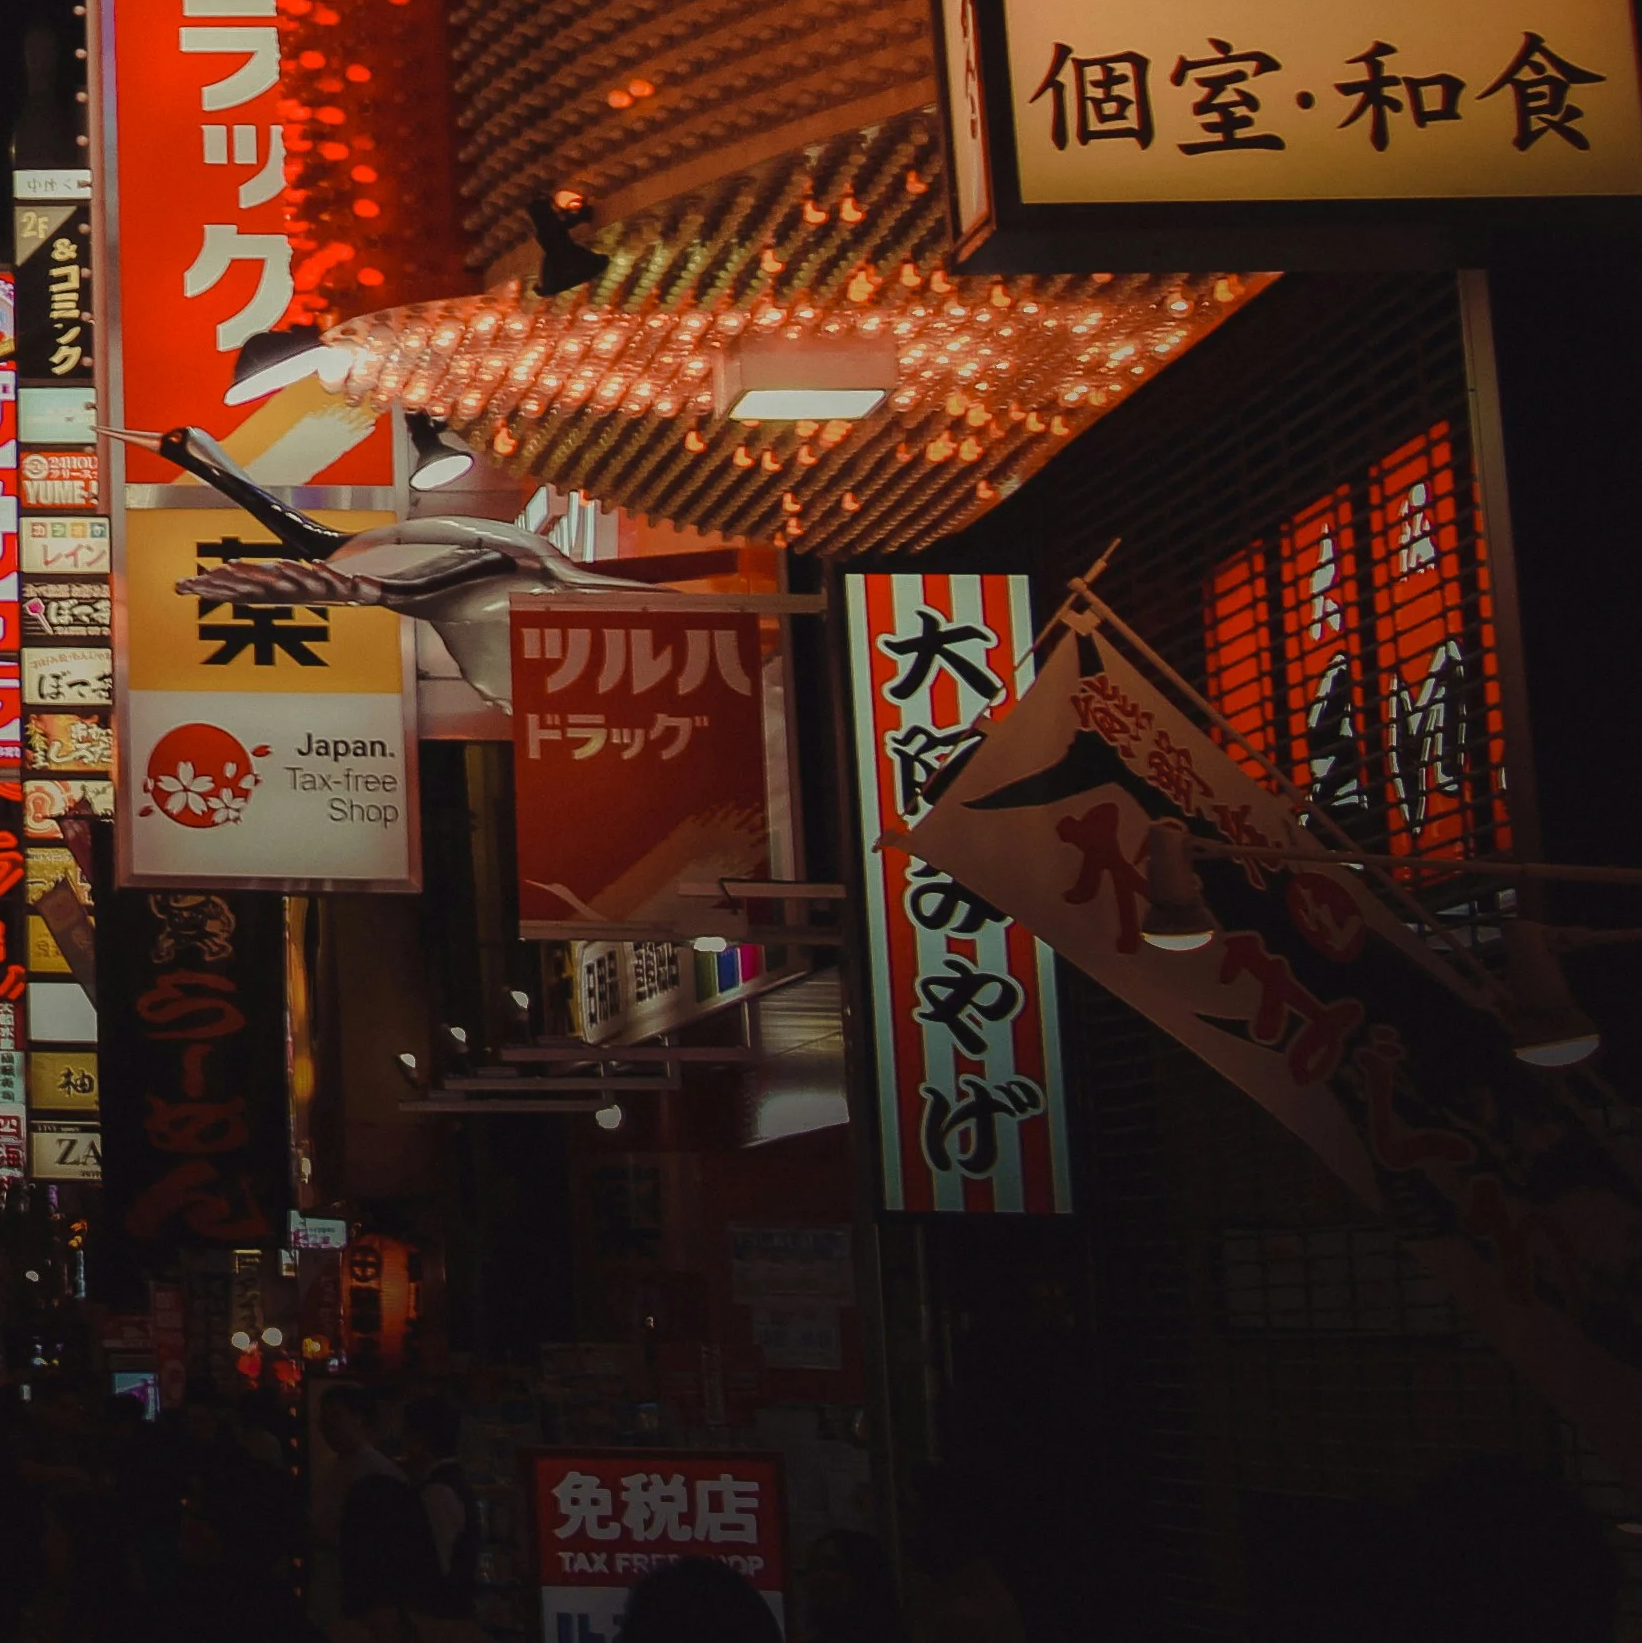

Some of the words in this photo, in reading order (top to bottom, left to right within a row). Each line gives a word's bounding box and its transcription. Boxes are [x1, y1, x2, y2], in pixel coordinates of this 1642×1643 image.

[1029, 31, 1607, 156] 個室・和食
[21, 211, 50, 239] 2F
[520, 627, 753, 697] ツルハ
[296, 732, 396, 761] Japan.
[525, 712, 710, 761] ドラッグ
[282, 764, 399, 794] Tax-free
[326, 796, 400, 827] Shop
[123, 968, 273, 1241] らーめん
[550, 1472, 761, 1546] 免税店
[556, 1550, 610, 1575] TAX
[613, 1551, 680, 1575] FRE
